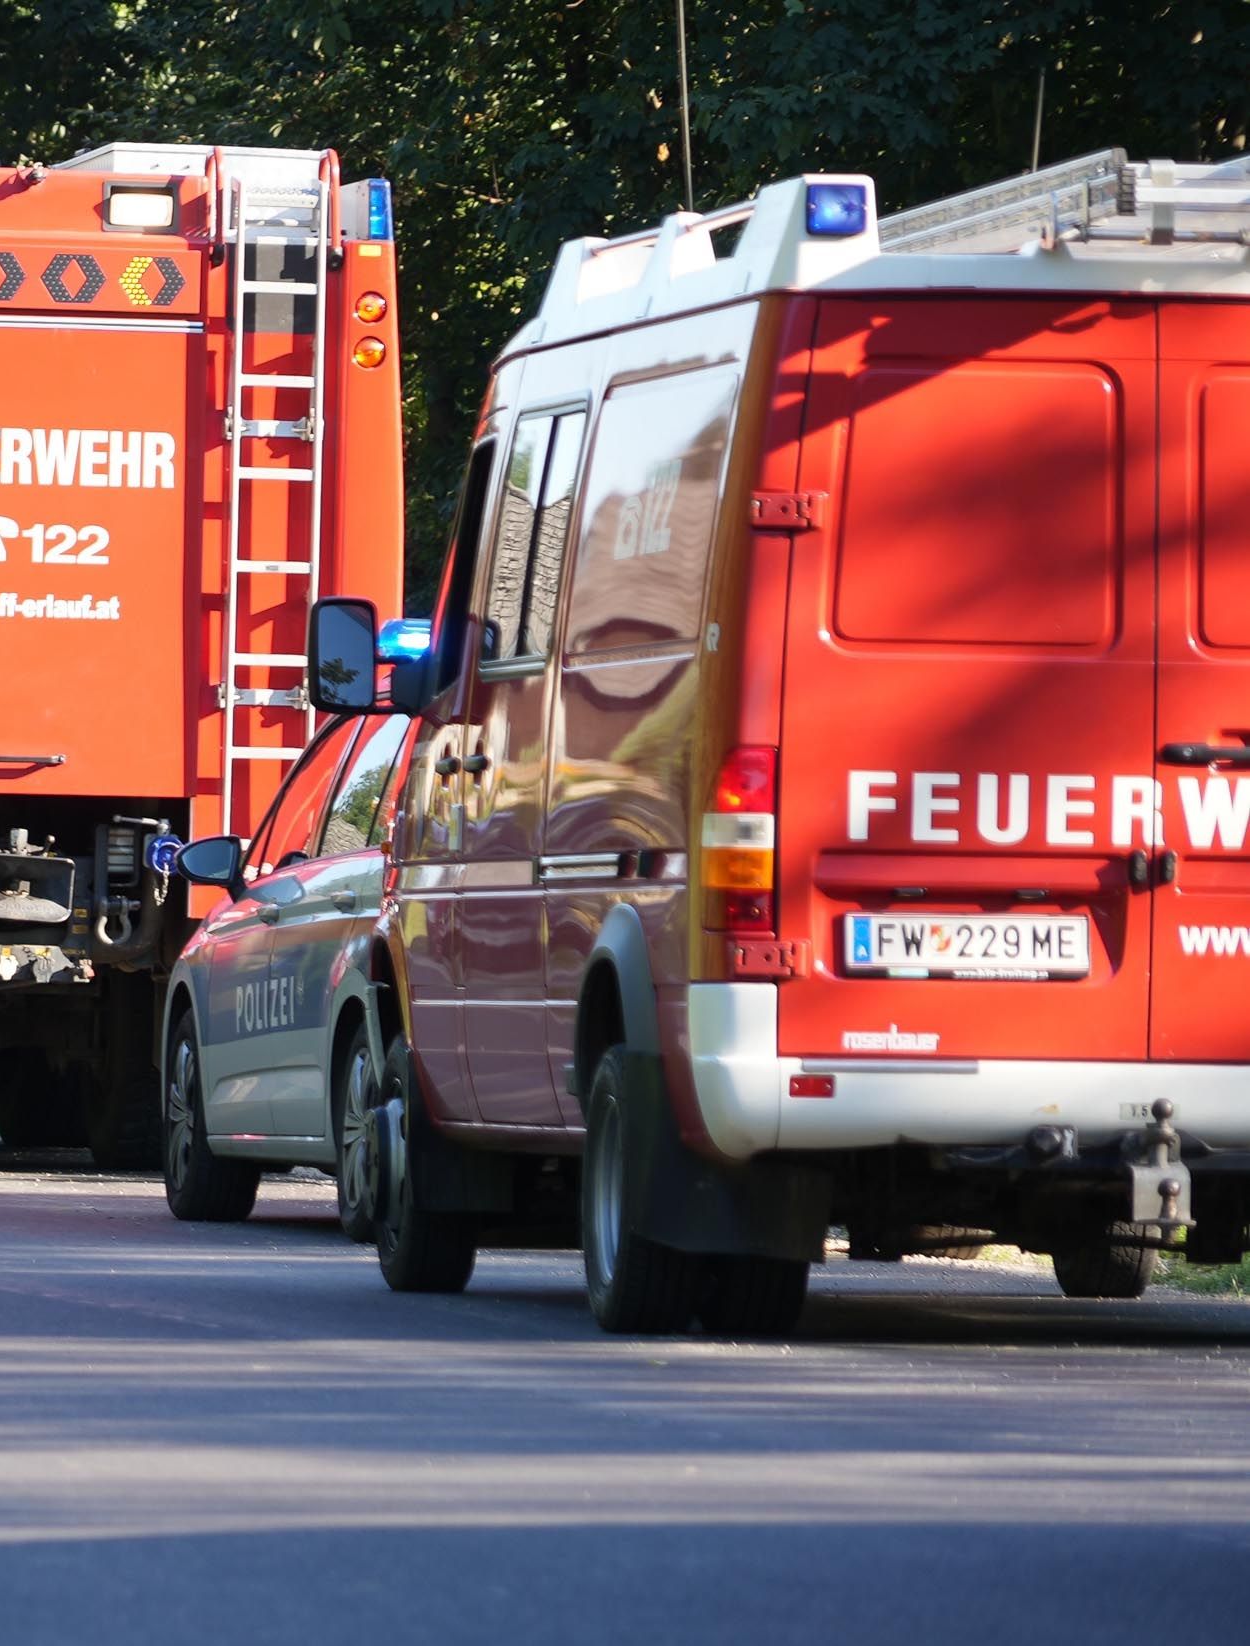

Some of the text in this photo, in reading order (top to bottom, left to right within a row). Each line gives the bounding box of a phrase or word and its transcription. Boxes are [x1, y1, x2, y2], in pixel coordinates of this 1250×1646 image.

[21, 523, 110, 565] 122
[847, 769, 1250, 850] FEUERW
[878, 923, 925, 958] FW
[956, 923, 1021, 959] 229
[1032, 925, 1076, 959] ME
[236, 975, 295, 1034] POLIZEI
[842, 1022, 941, 1051] rosenbauer
